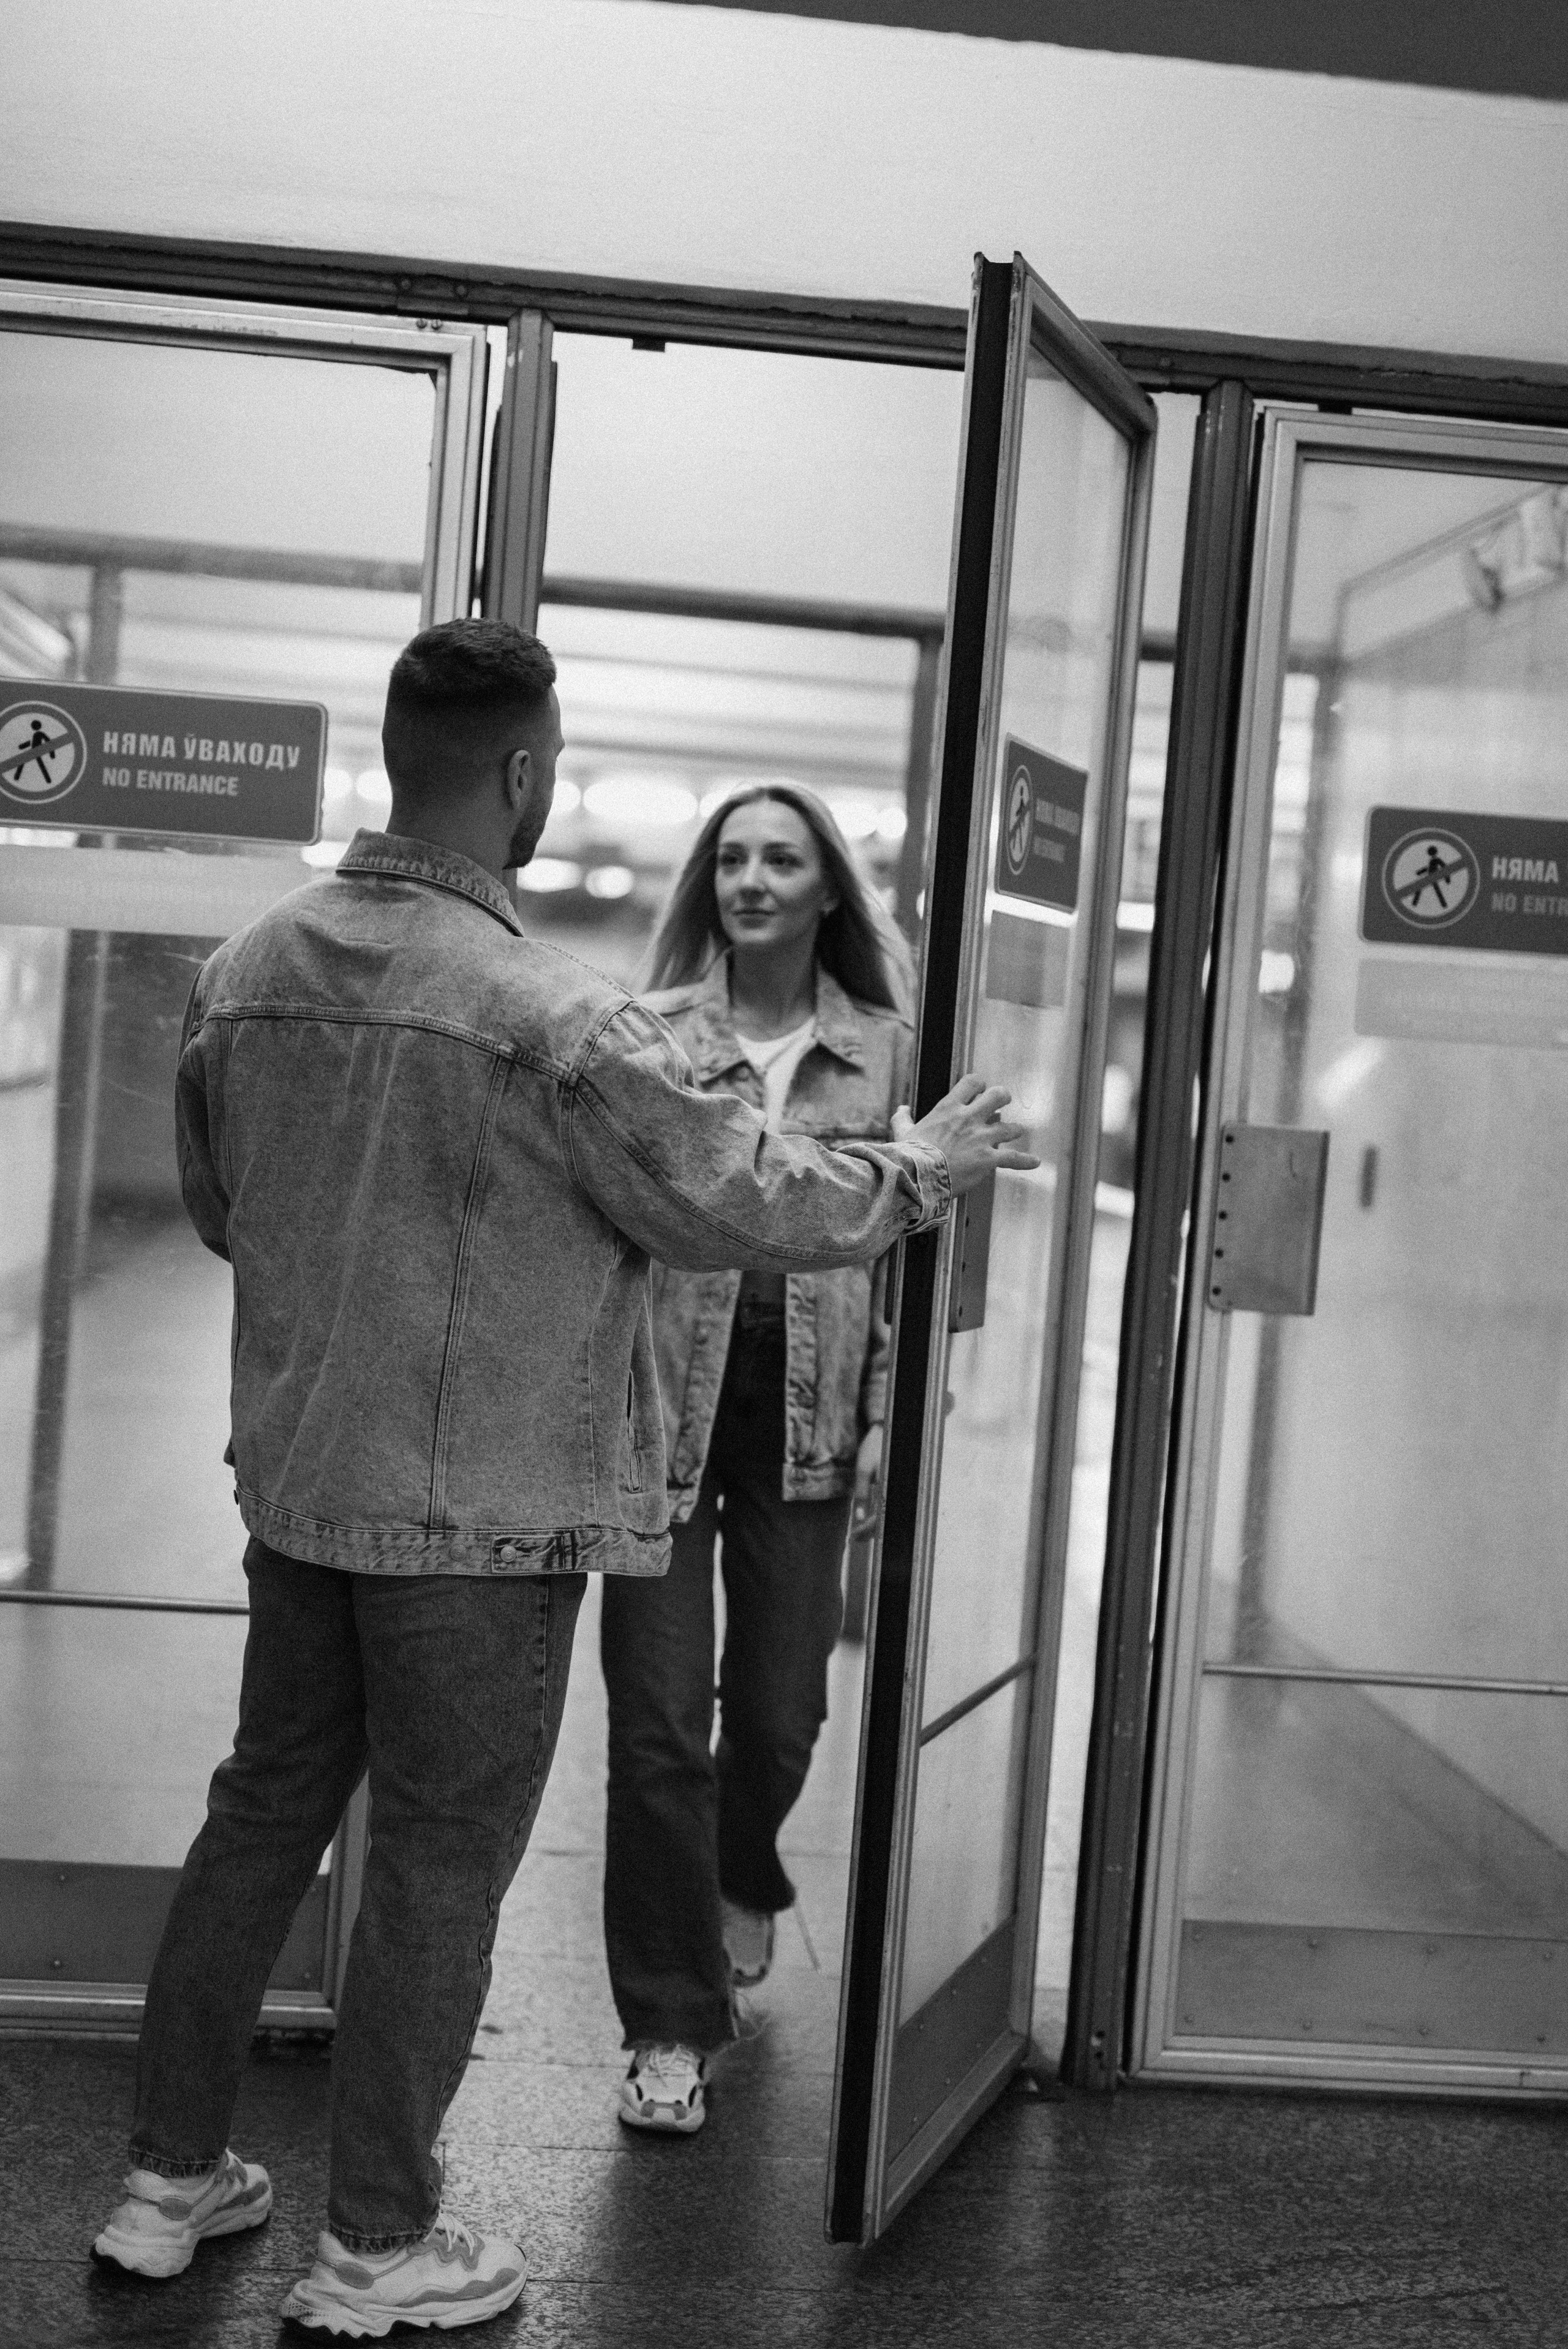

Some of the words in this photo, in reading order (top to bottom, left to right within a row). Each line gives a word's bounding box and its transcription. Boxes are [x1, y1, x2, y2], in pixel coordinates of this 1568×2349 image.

[103, 731, 176, 758] НЯМА
[102, 767, 130, 788] NO
[136, 769, 239, 796] ENTRANCE
[1492, 856, 1559, 883] НЯМА
